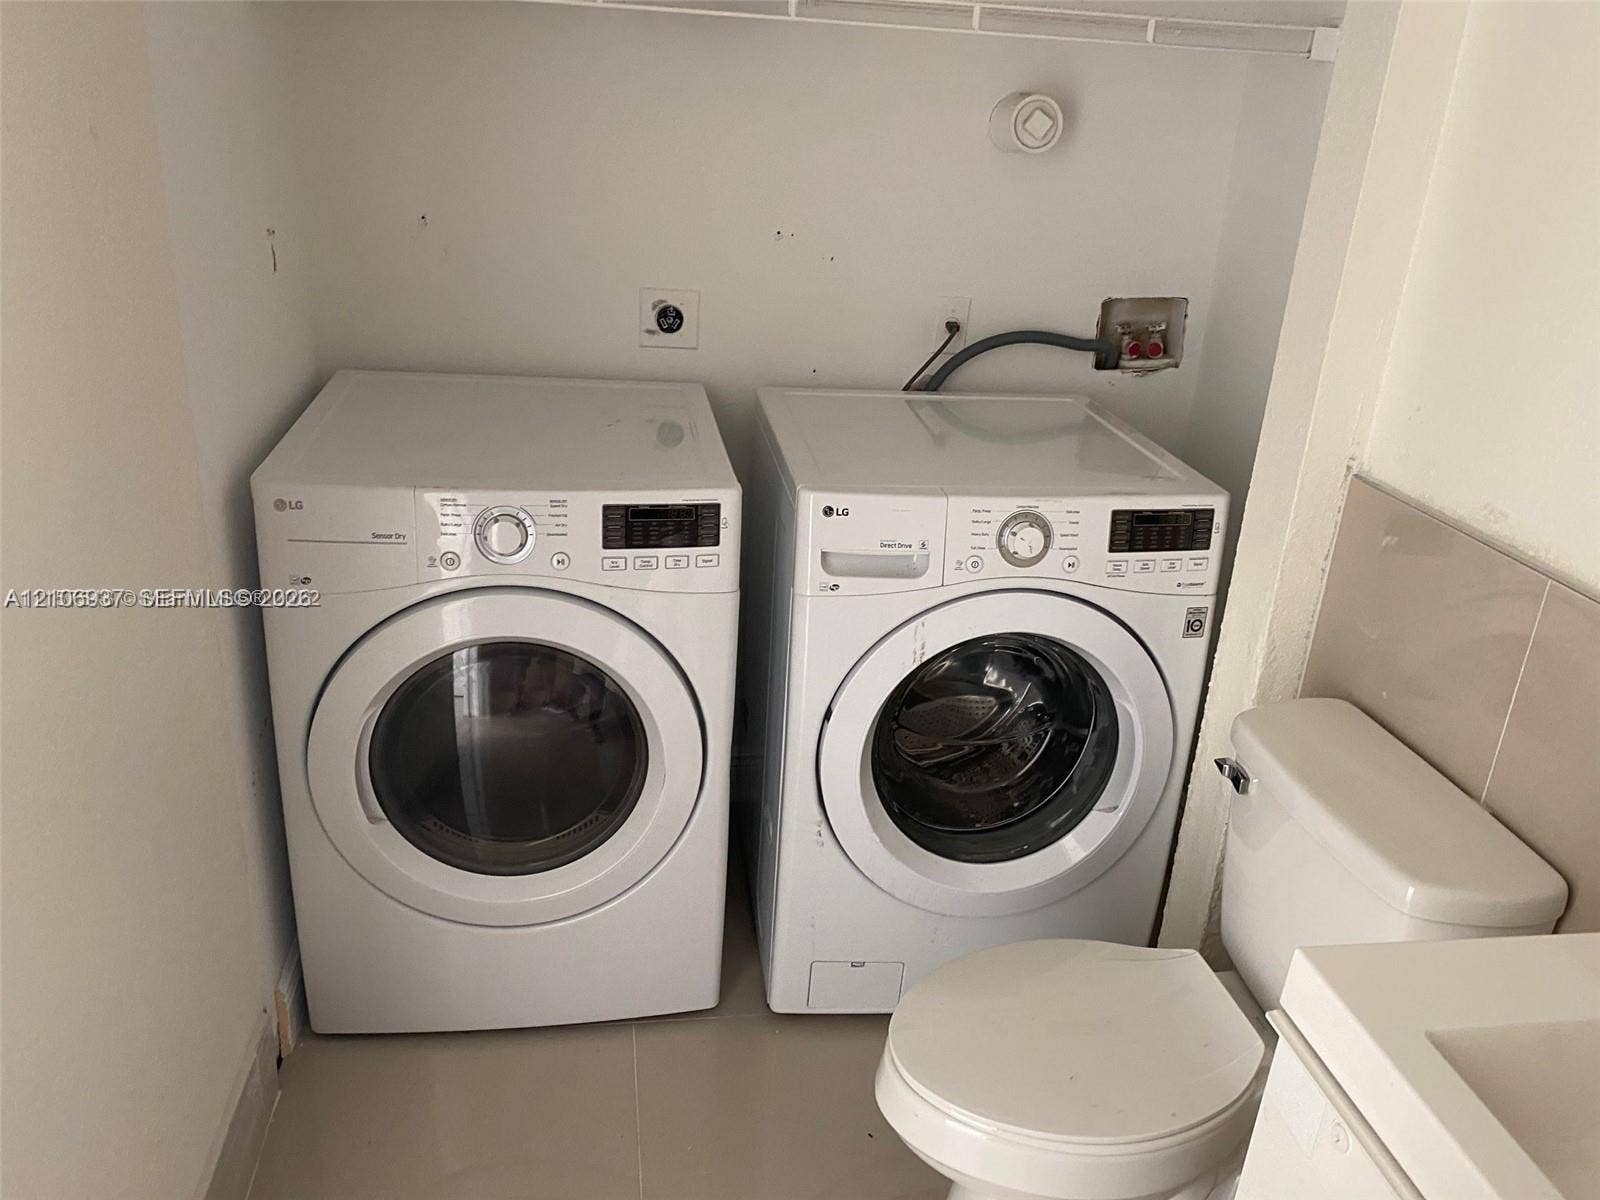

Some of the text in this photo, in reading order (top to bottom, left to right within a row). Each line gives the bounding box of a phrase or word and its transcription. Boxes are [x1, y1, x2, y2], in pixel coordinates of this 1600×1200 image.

[288, 500, 304, 510] LG
[835, 507, 849, 517] LG
[371, 532, 406, 541] Sensor Dry
